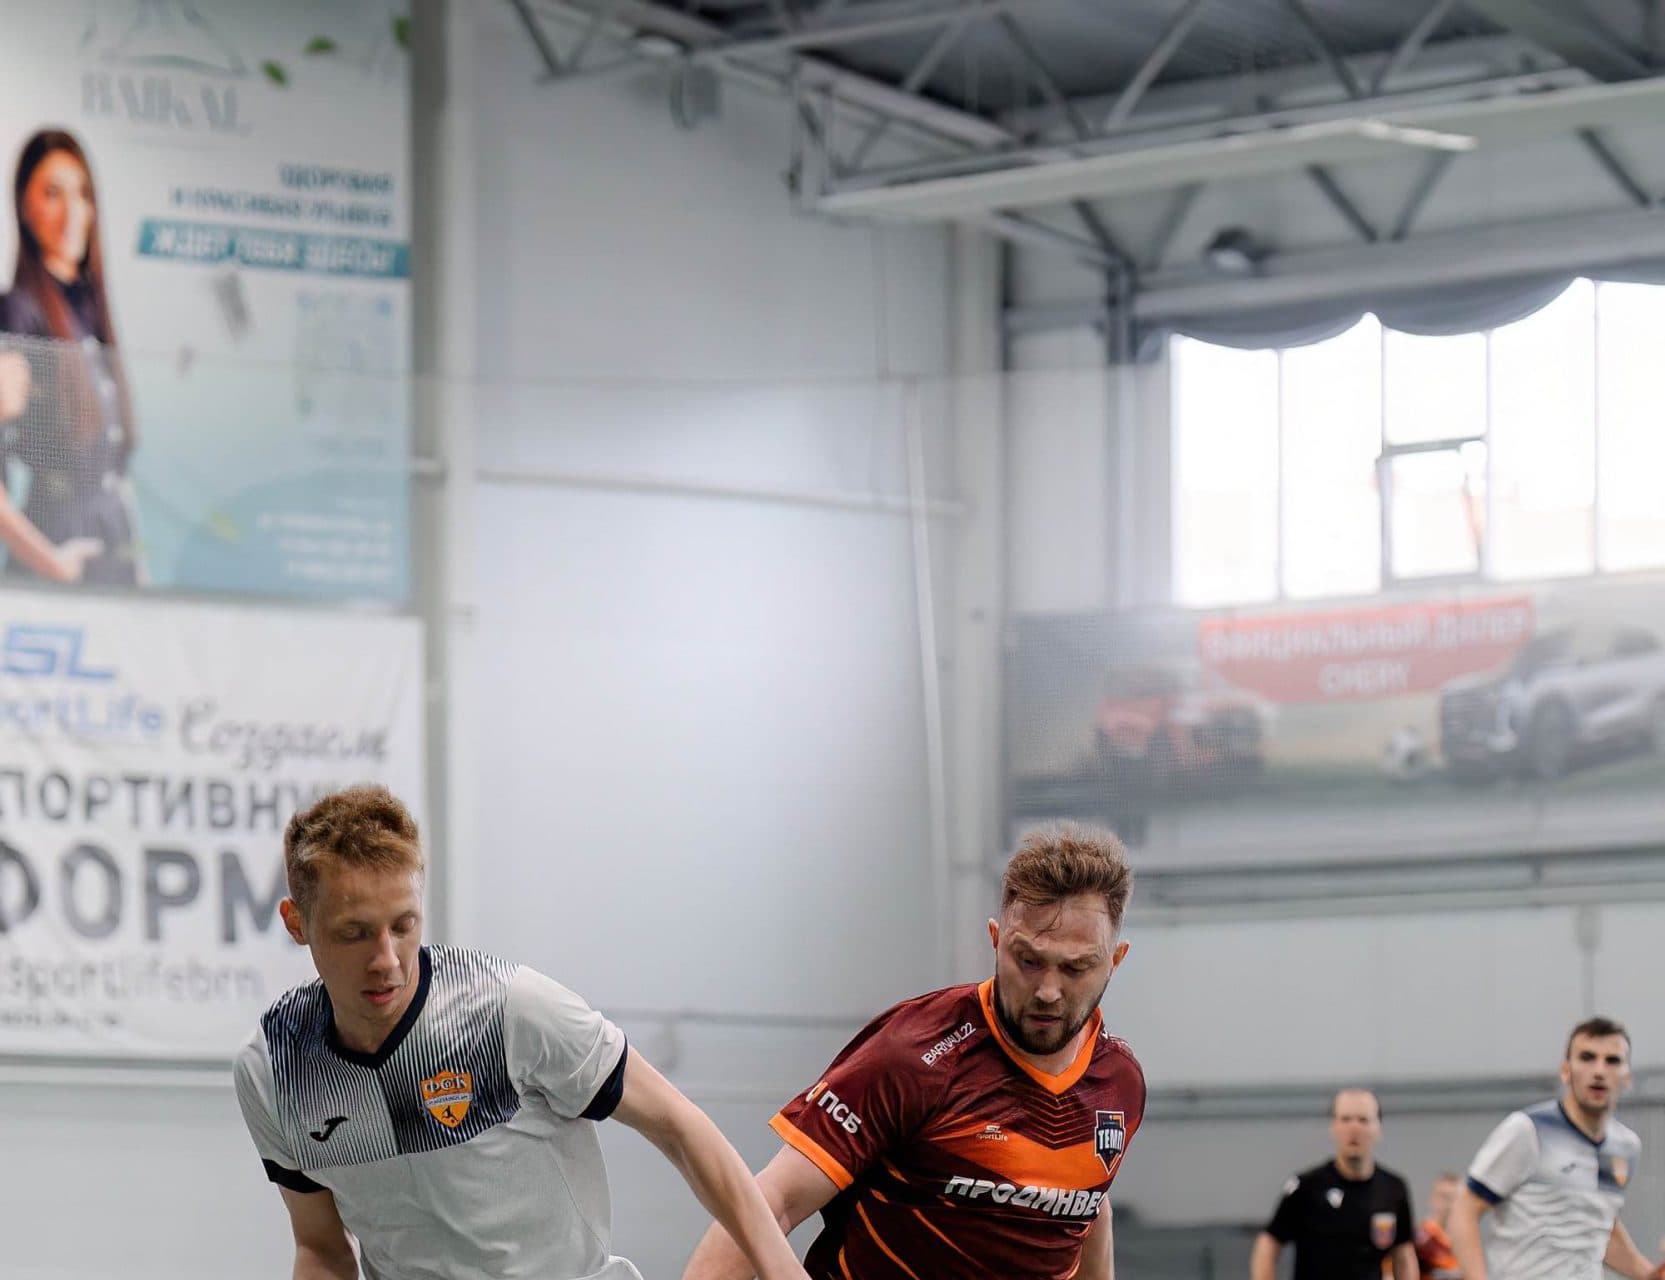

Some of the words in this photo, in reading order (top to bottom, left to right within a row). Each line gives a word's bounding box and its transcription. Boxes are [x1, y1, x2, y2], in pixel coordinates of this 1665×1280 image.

[425, 1076, 467, 1093] ФОК
[818, 1090, 862, 1134] ПСБ
[1098, 1129, 1123, 1150] ТЕМП
